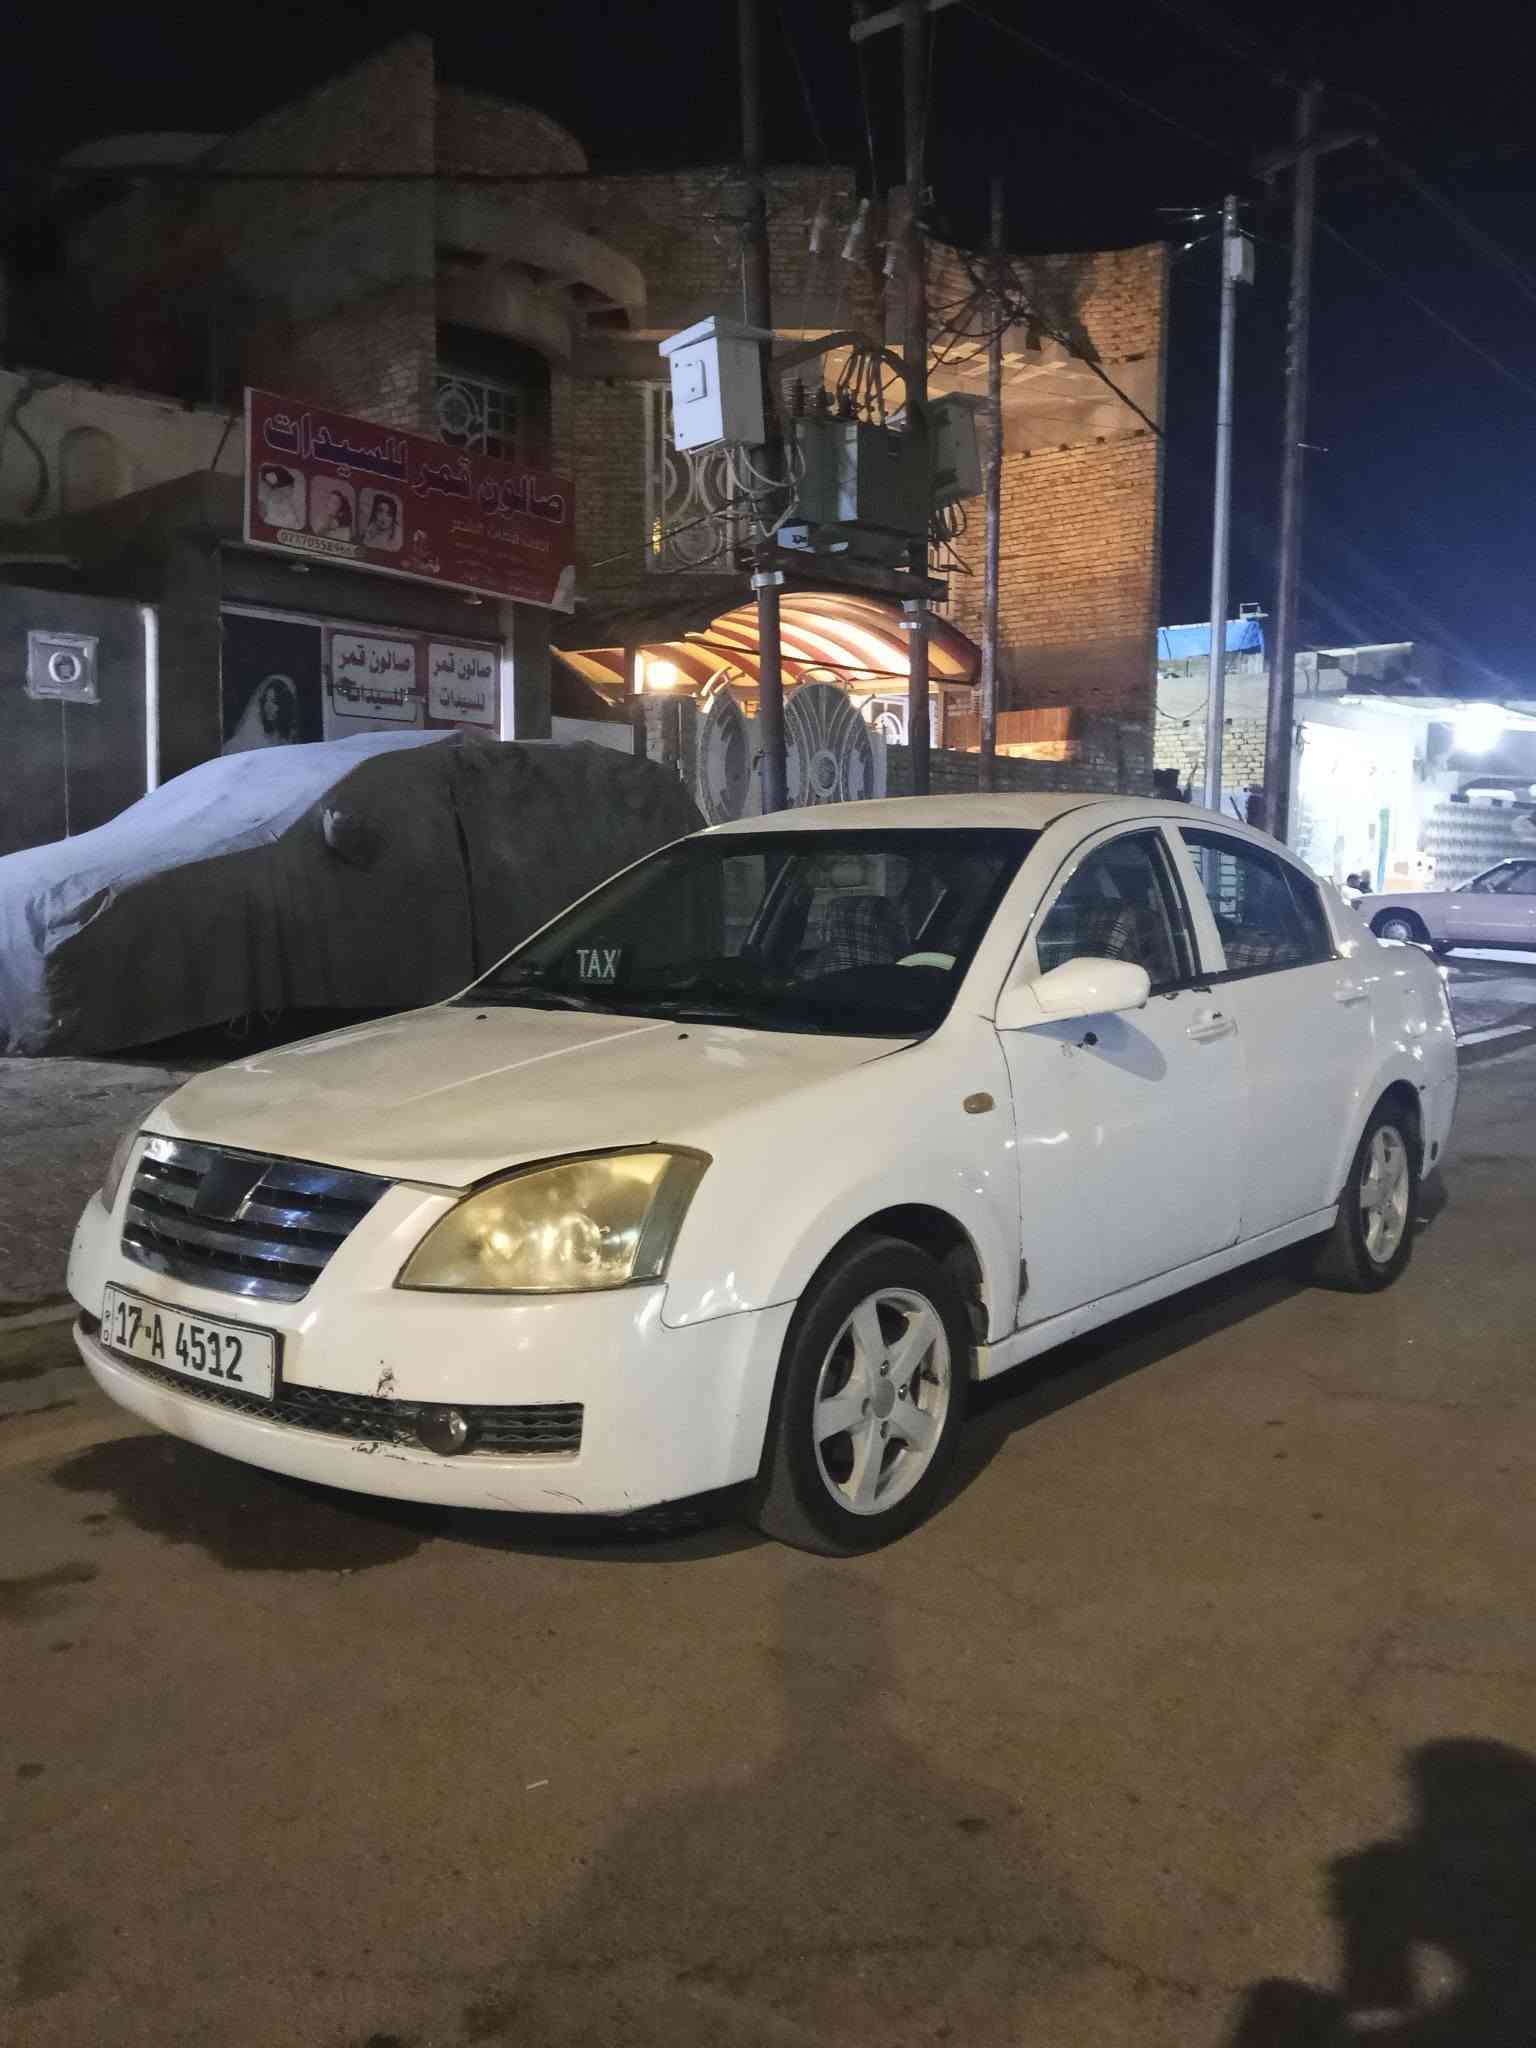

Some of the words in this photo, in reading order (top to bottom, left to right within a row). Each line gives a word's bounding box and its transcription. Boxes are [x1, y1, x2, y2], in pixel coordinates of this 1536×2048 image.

[338, 644, 366, 671] قمر
[369, 648, 410, 674] صالون
[432, 652, 456, 677] قمر
[457, 657, 492, 681] صالون
[175, 1322, 243, 1383] 4512
